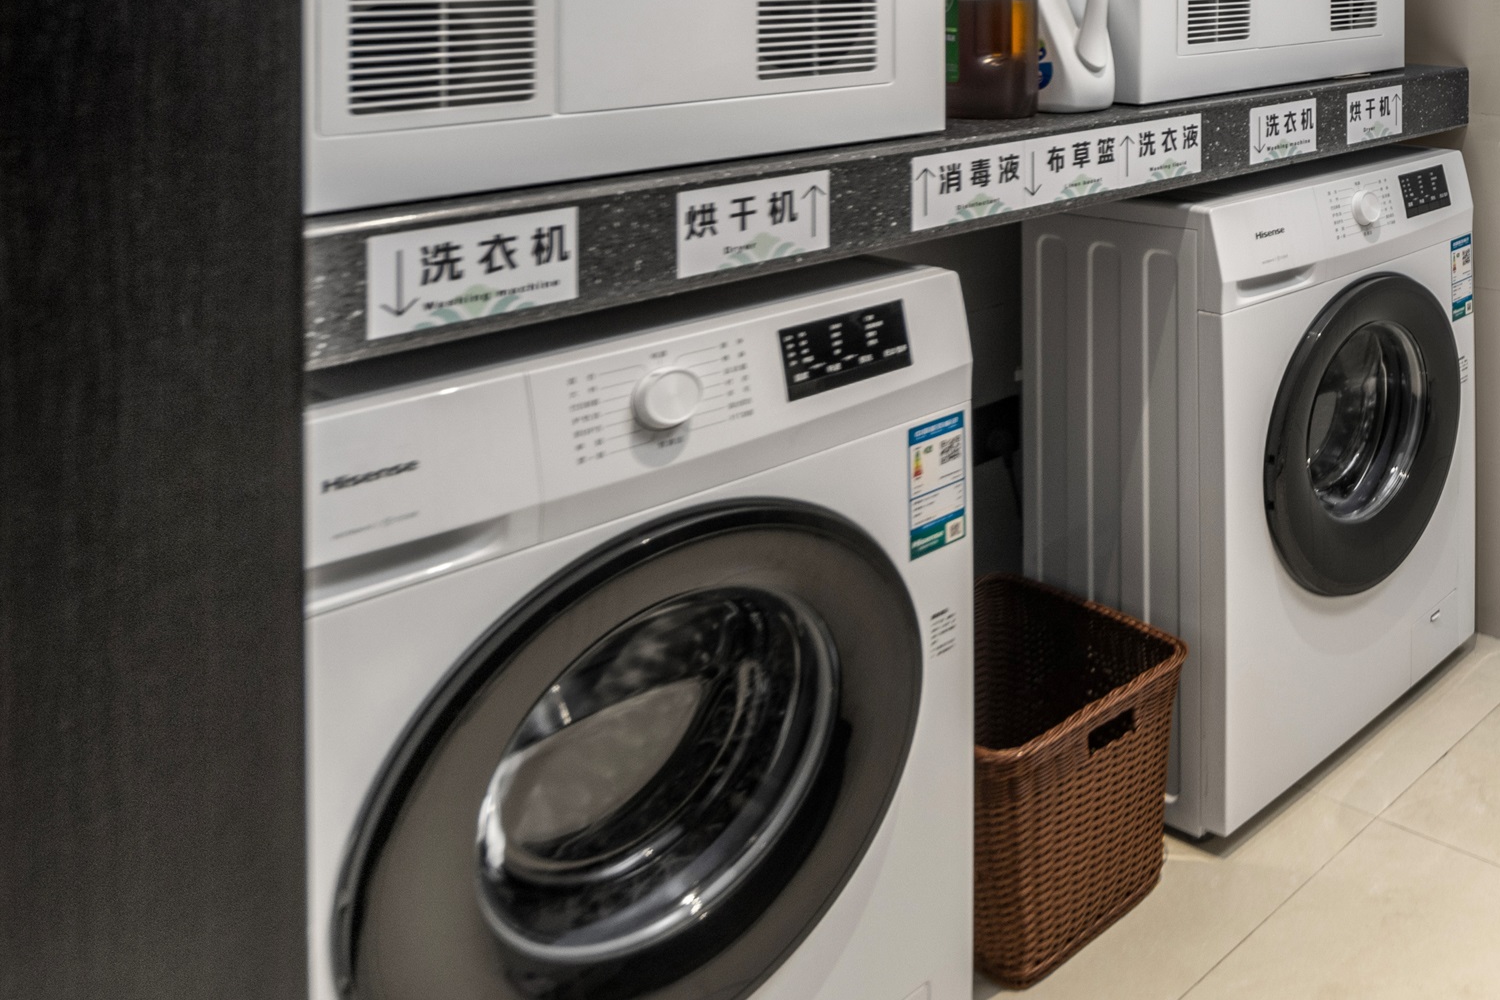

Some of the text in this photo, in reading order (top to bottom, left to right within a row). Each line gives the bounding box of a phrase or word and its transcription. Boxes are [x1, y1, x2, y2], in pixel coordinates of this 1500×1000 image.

[1265, 108, 1314, 138] 洗衣机
[1349, 96, 1391, 123] 烘干机
[1047, 136, 1116, 173] 布草篮
[1138, 123, 1199, 158] 洗衣液
[1266, 139, 1311, 152] Washing machine
[938, 153, 1021, 195] 消毒液
[684, 189, 798, 241] 烘干机
[723, 242, 757, 256] Dryer
[1255, 226, 1286, 240] Hisense
[419, 224, 571, 287] 洗衣机
[423, 279, 561, 311] Washing machine
[319, 458, 420, 494] Hisense
